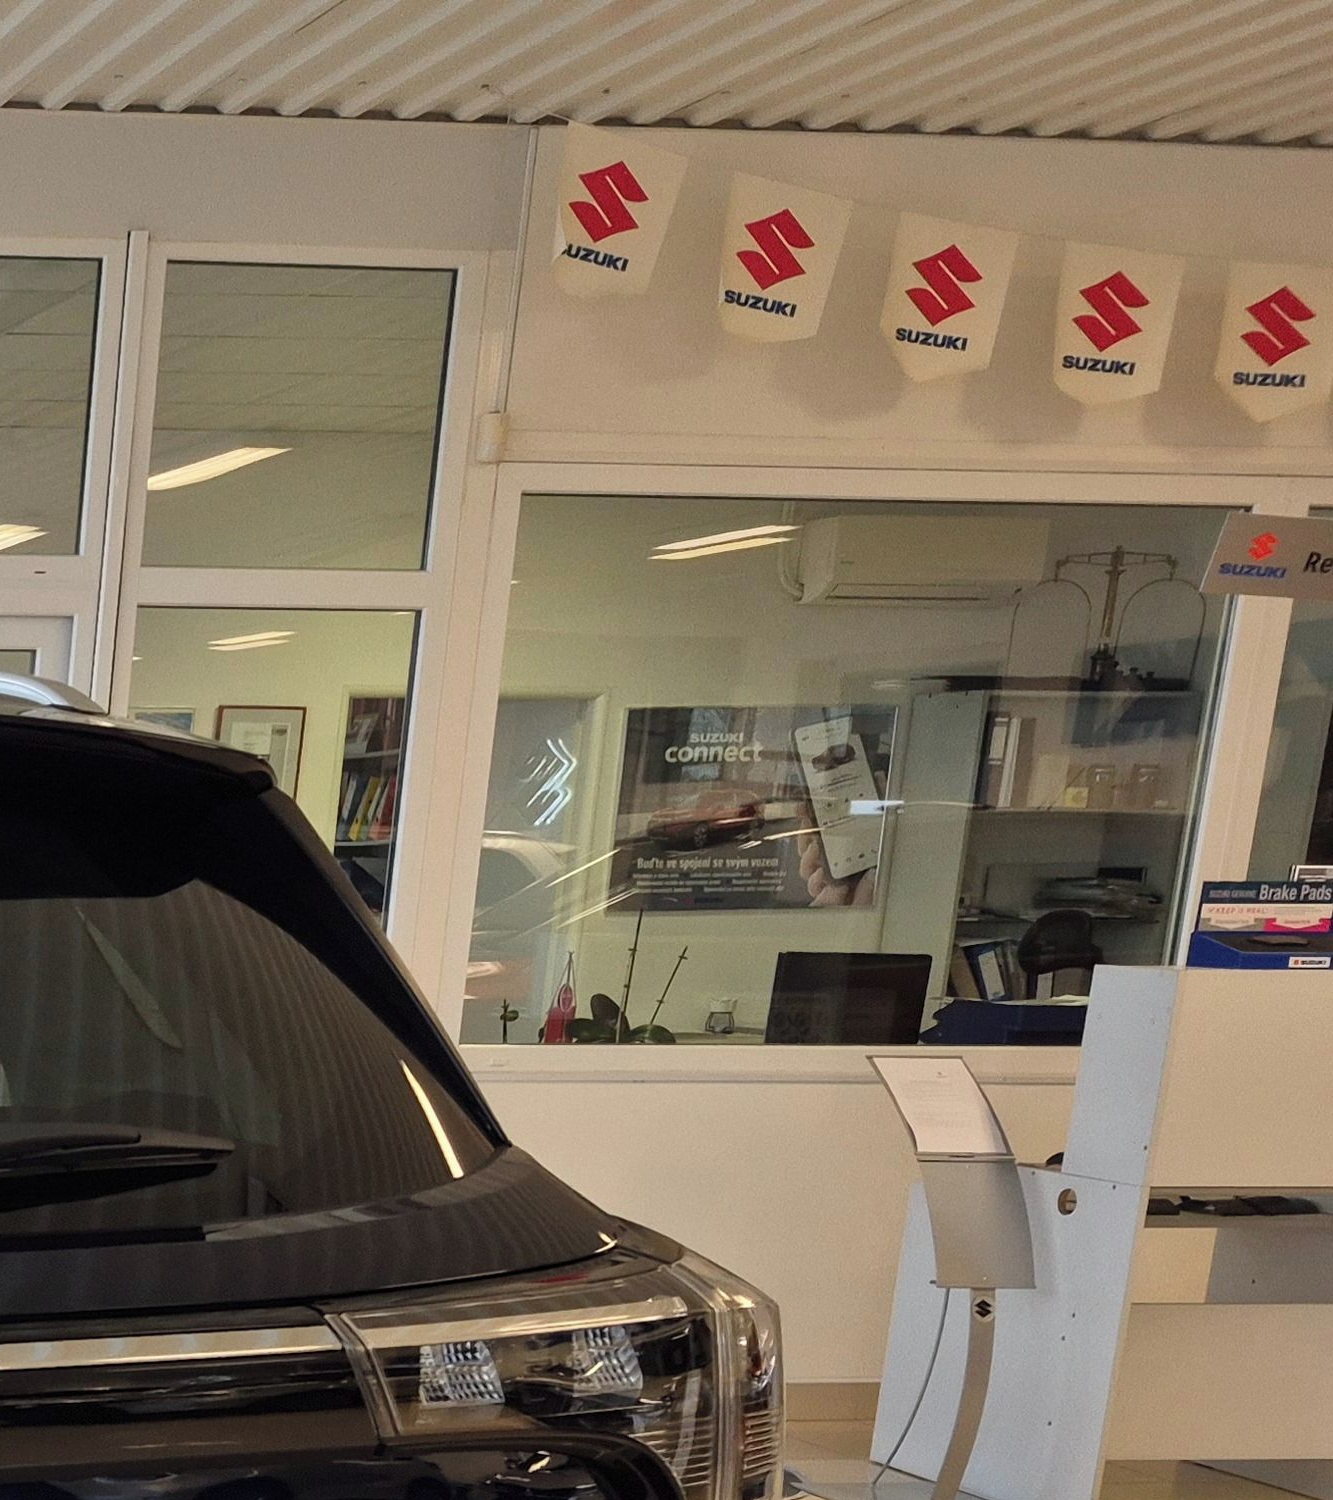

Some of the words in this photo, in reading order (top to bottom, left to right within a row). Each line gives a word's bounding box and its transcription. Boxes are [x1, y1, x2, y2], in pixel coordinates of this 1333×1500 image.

[562, 243, 630, 272] UZUKI
[724, 289, 798, 318] SUZUKI
[895, 327, 968, 352] SUZUKI
[1062, 354, 1136, 376] SUZUKI
[1232, 371, 1306, 388] SUZUKI
[1218, 562, 1288, 580] SUZUKI
[1303, 551, 1333, 574] Re
[689, 731, 744, 744] SUZUKI
[664, 741, 764, 763] connect
[1259, 884, 1297, 901] Brake
[1299, 884, 1333, 901] Pads
